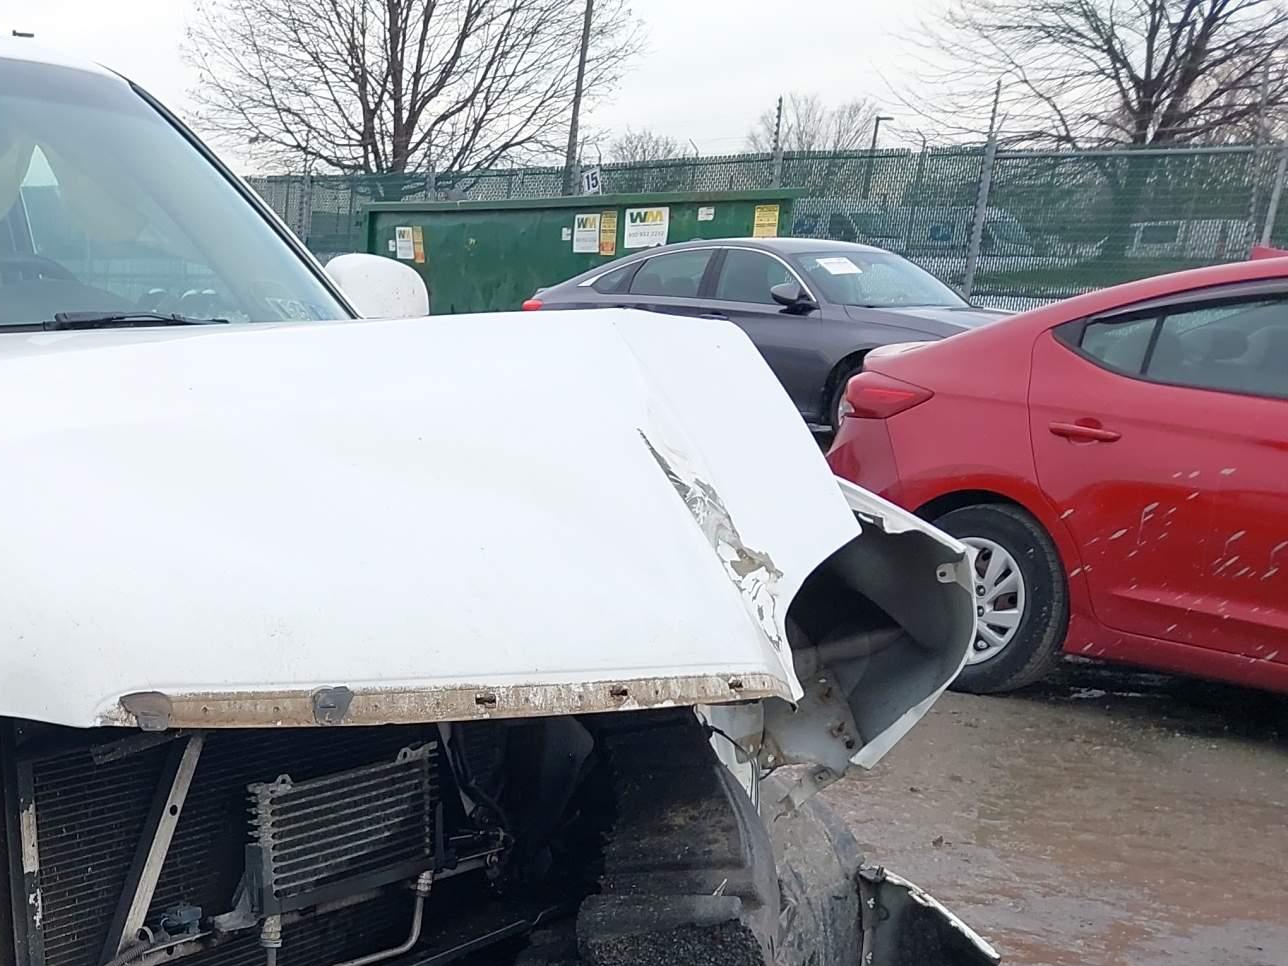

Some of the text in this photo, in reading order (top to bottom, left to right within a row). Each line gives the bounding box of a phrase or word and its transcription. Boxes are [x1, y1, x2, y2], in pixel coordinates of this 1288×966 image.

[585, 172, 599, 191] 15
[577, 217, 596, 229] WM
[629, 211, 664, 223] WM
